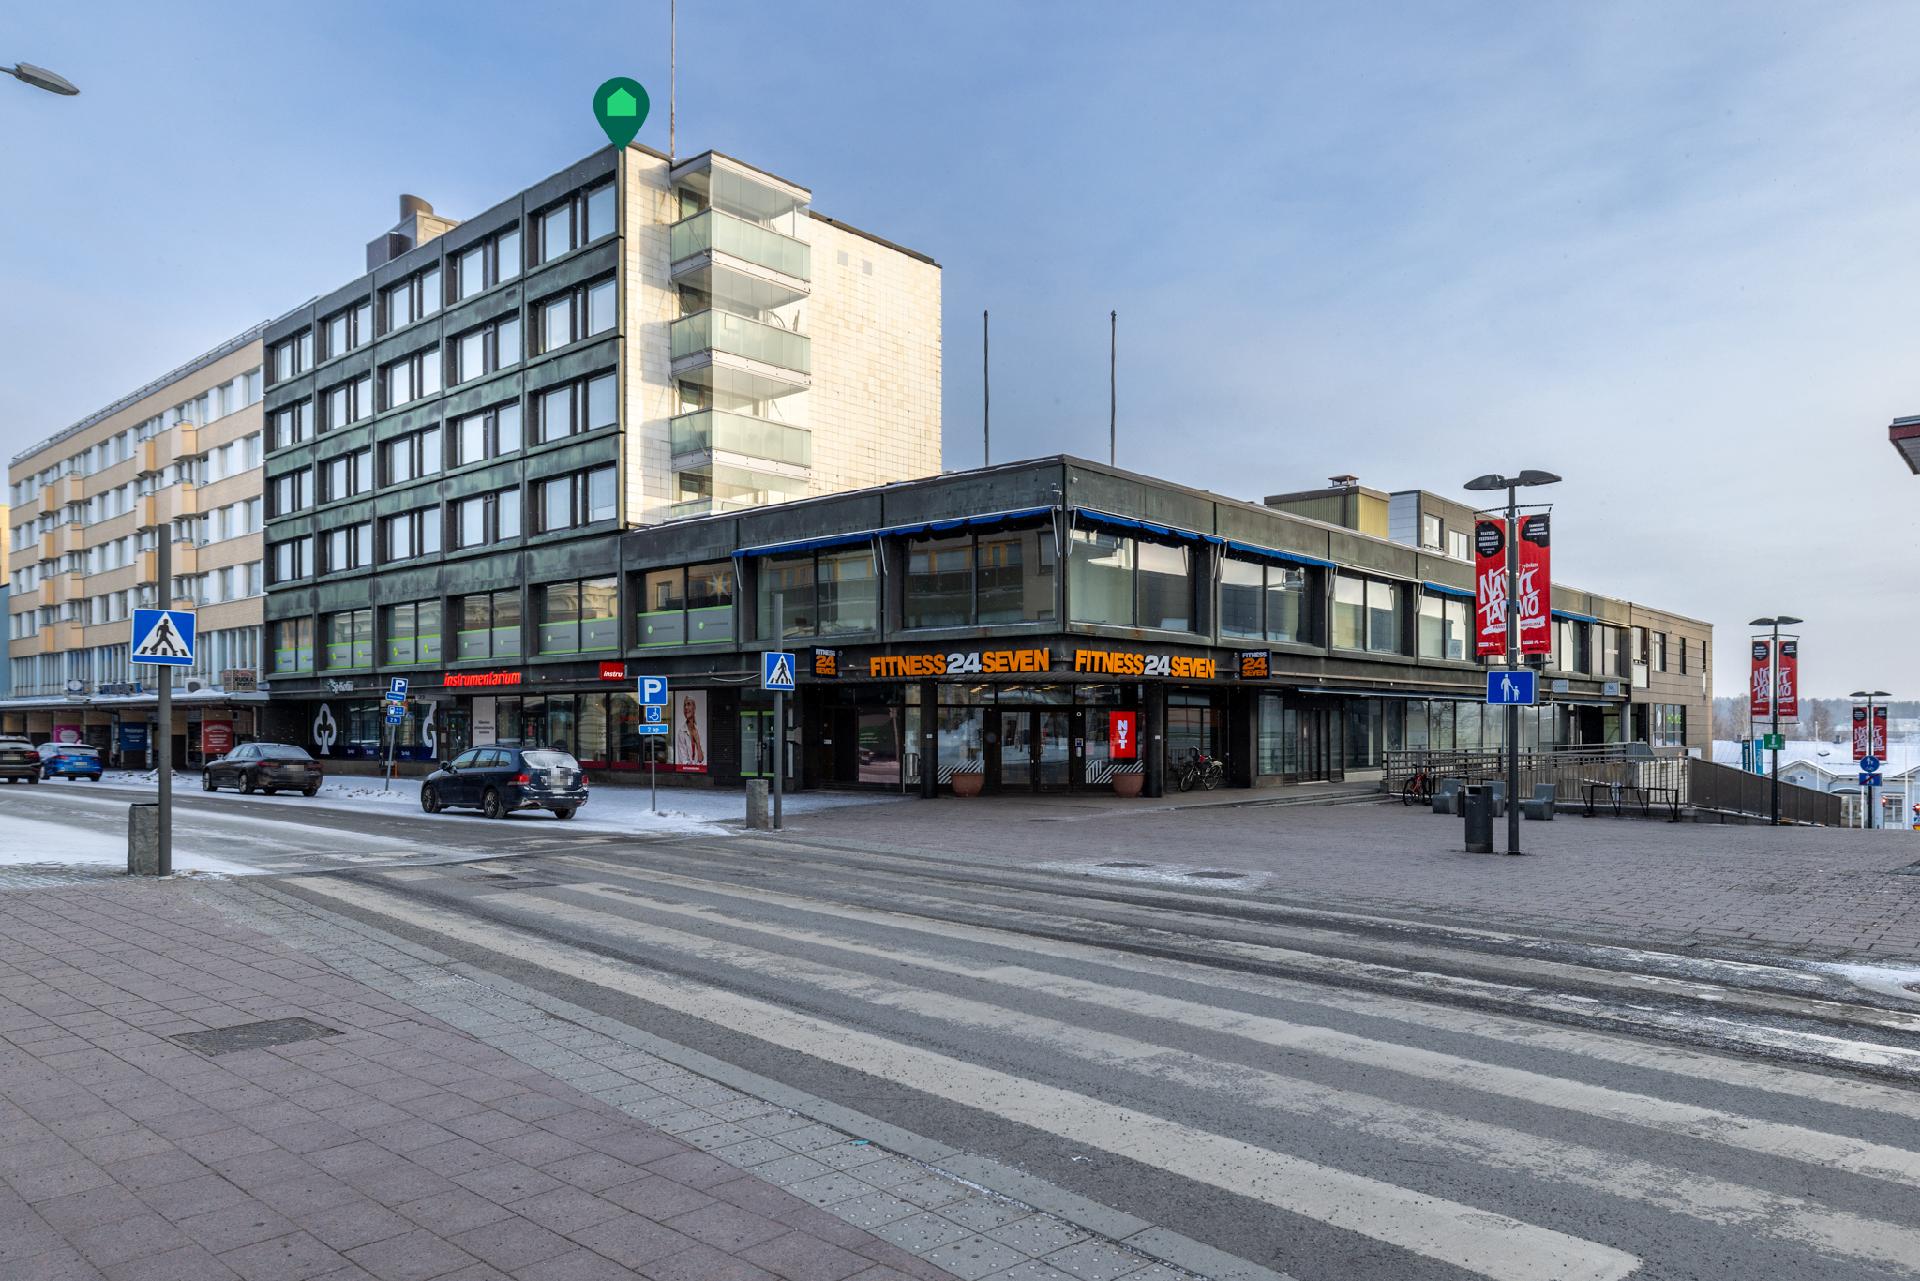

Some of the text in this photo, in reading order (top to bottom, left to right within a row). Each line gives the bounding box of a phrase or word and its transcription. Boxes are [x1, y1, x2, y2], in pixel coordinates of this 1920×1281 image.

[815, 655, 836, 668] 24
[1241, 657, 1268, 670] 24
[443, 671, 522, 687] instrumentarium
[603, 670, 624, 678] instru
[1241, 669, 1268, 677] SEVEN
[394, 679, 405, 692] P
[643, 679, 662, 703] P
[1117, 719, 1129, 749] NYT
